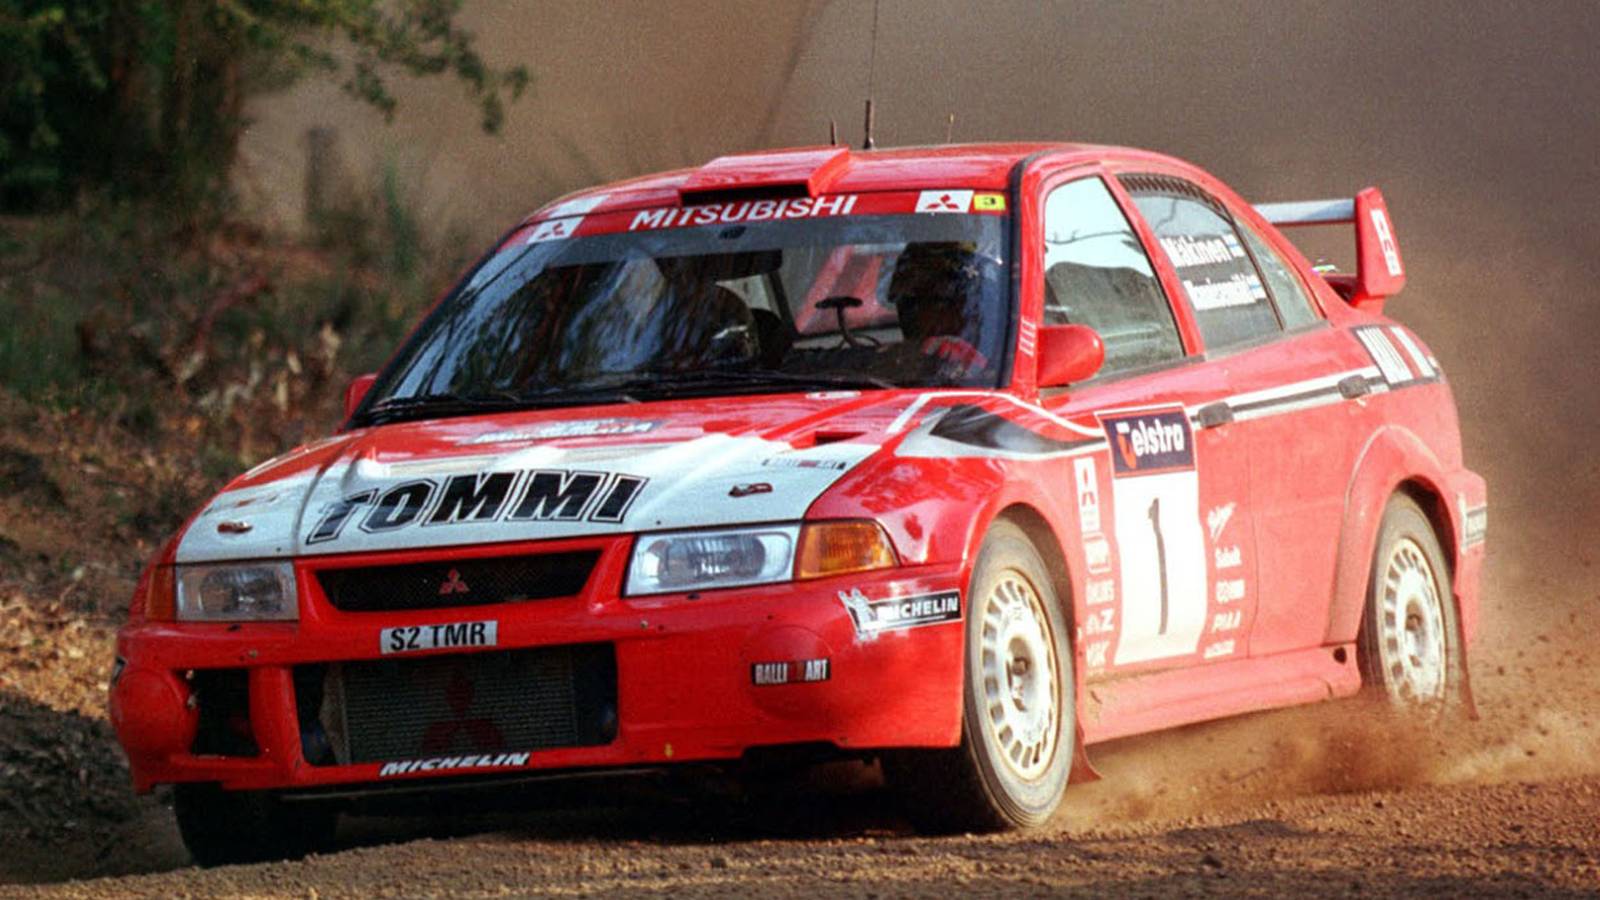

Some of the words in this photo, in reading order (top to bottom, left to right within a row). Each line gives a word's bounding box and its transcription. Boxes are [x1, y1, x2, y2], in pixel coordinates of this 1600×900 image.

[630, 195, 858, 230] MITSUBISHI
[1115, 418, 1185, 469] Telstra
[306, 468, 649, 545] TOMMI
[1149, 497, 1169, 635] 1
[390, 627, 422, 651] S2
[431, 622, 486, 648] TMR
[380, 752, 530, 777] MICHELIN
